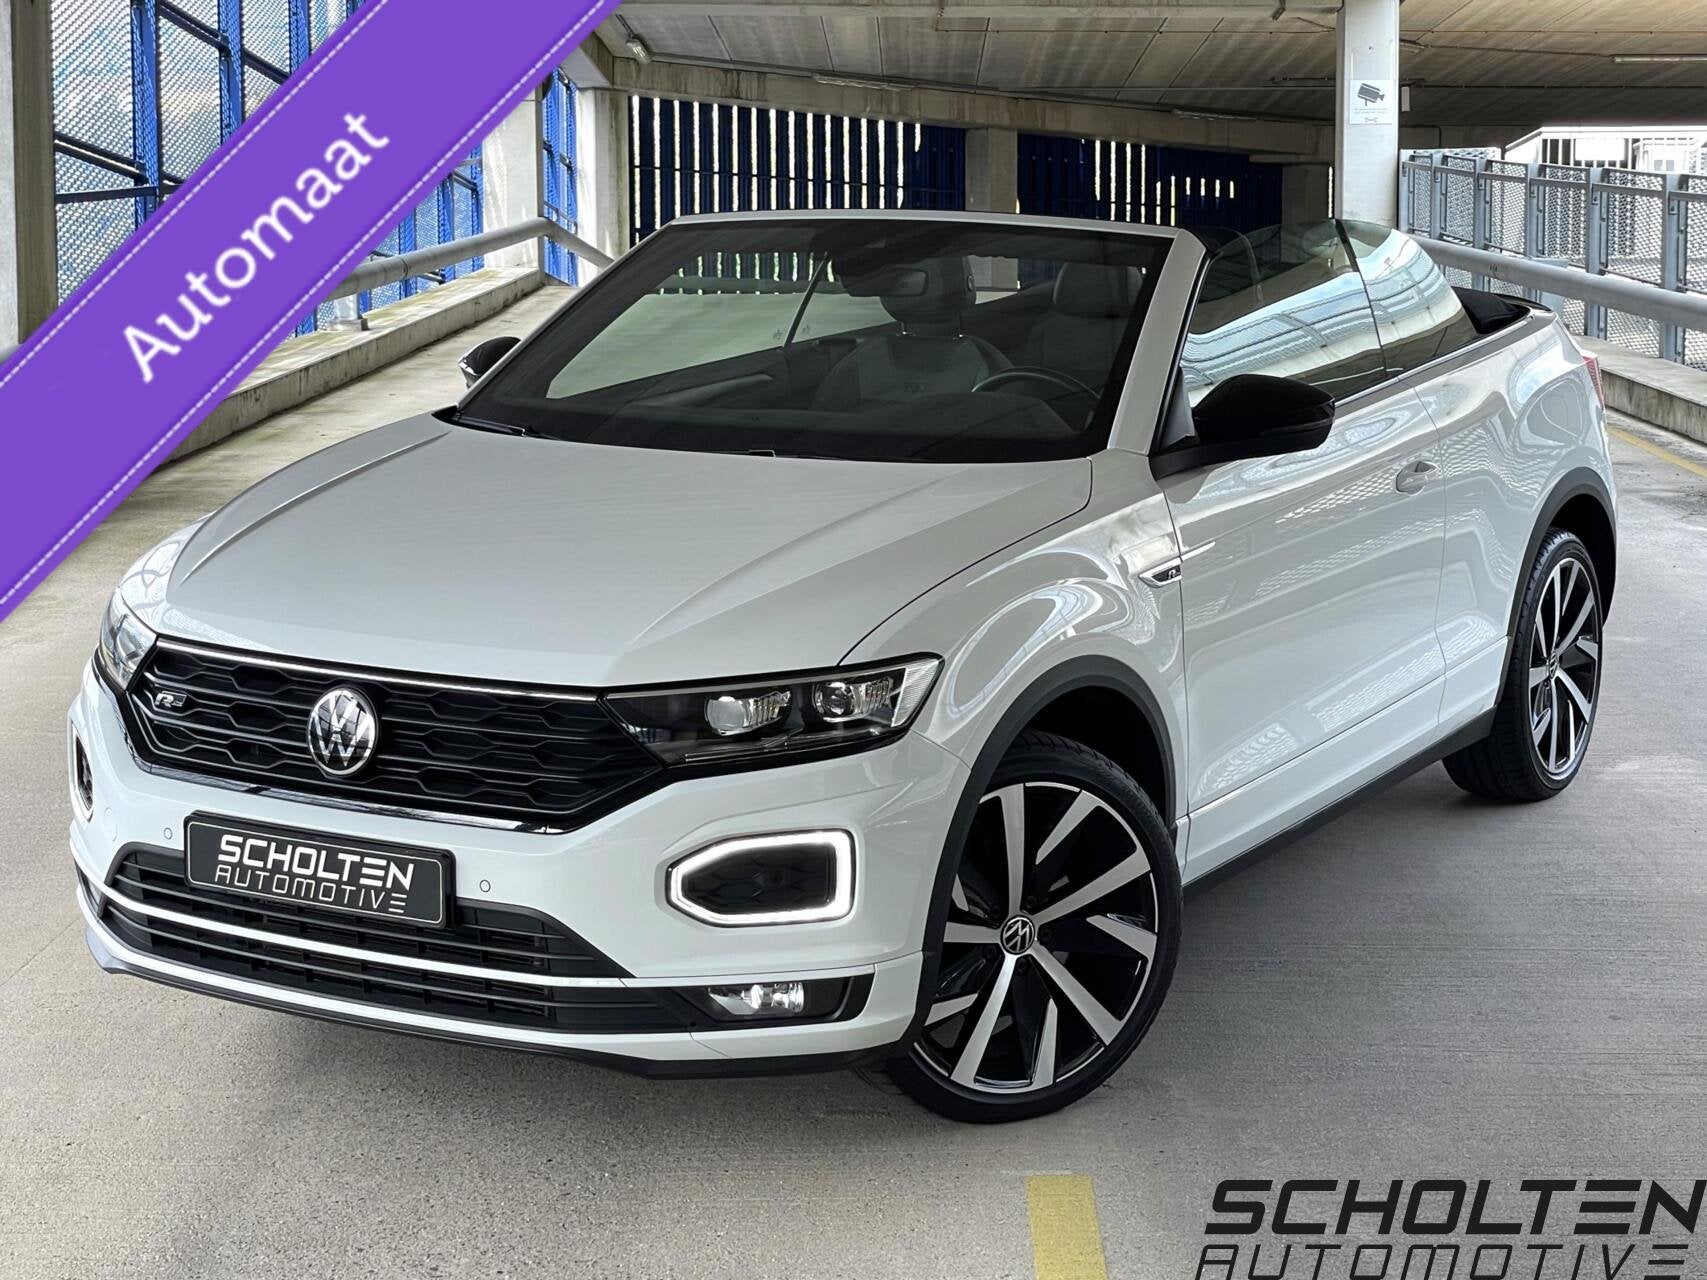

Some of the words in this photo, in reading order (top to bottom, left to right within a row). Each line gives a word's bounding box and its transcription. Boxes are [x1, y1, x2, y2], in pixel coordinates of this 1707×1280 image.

[308, 687, 378, 776] VW
[214, 865, 408, 914] AUTOMOTIVE
[218, 834, 415, 892] SCHOLTEN
